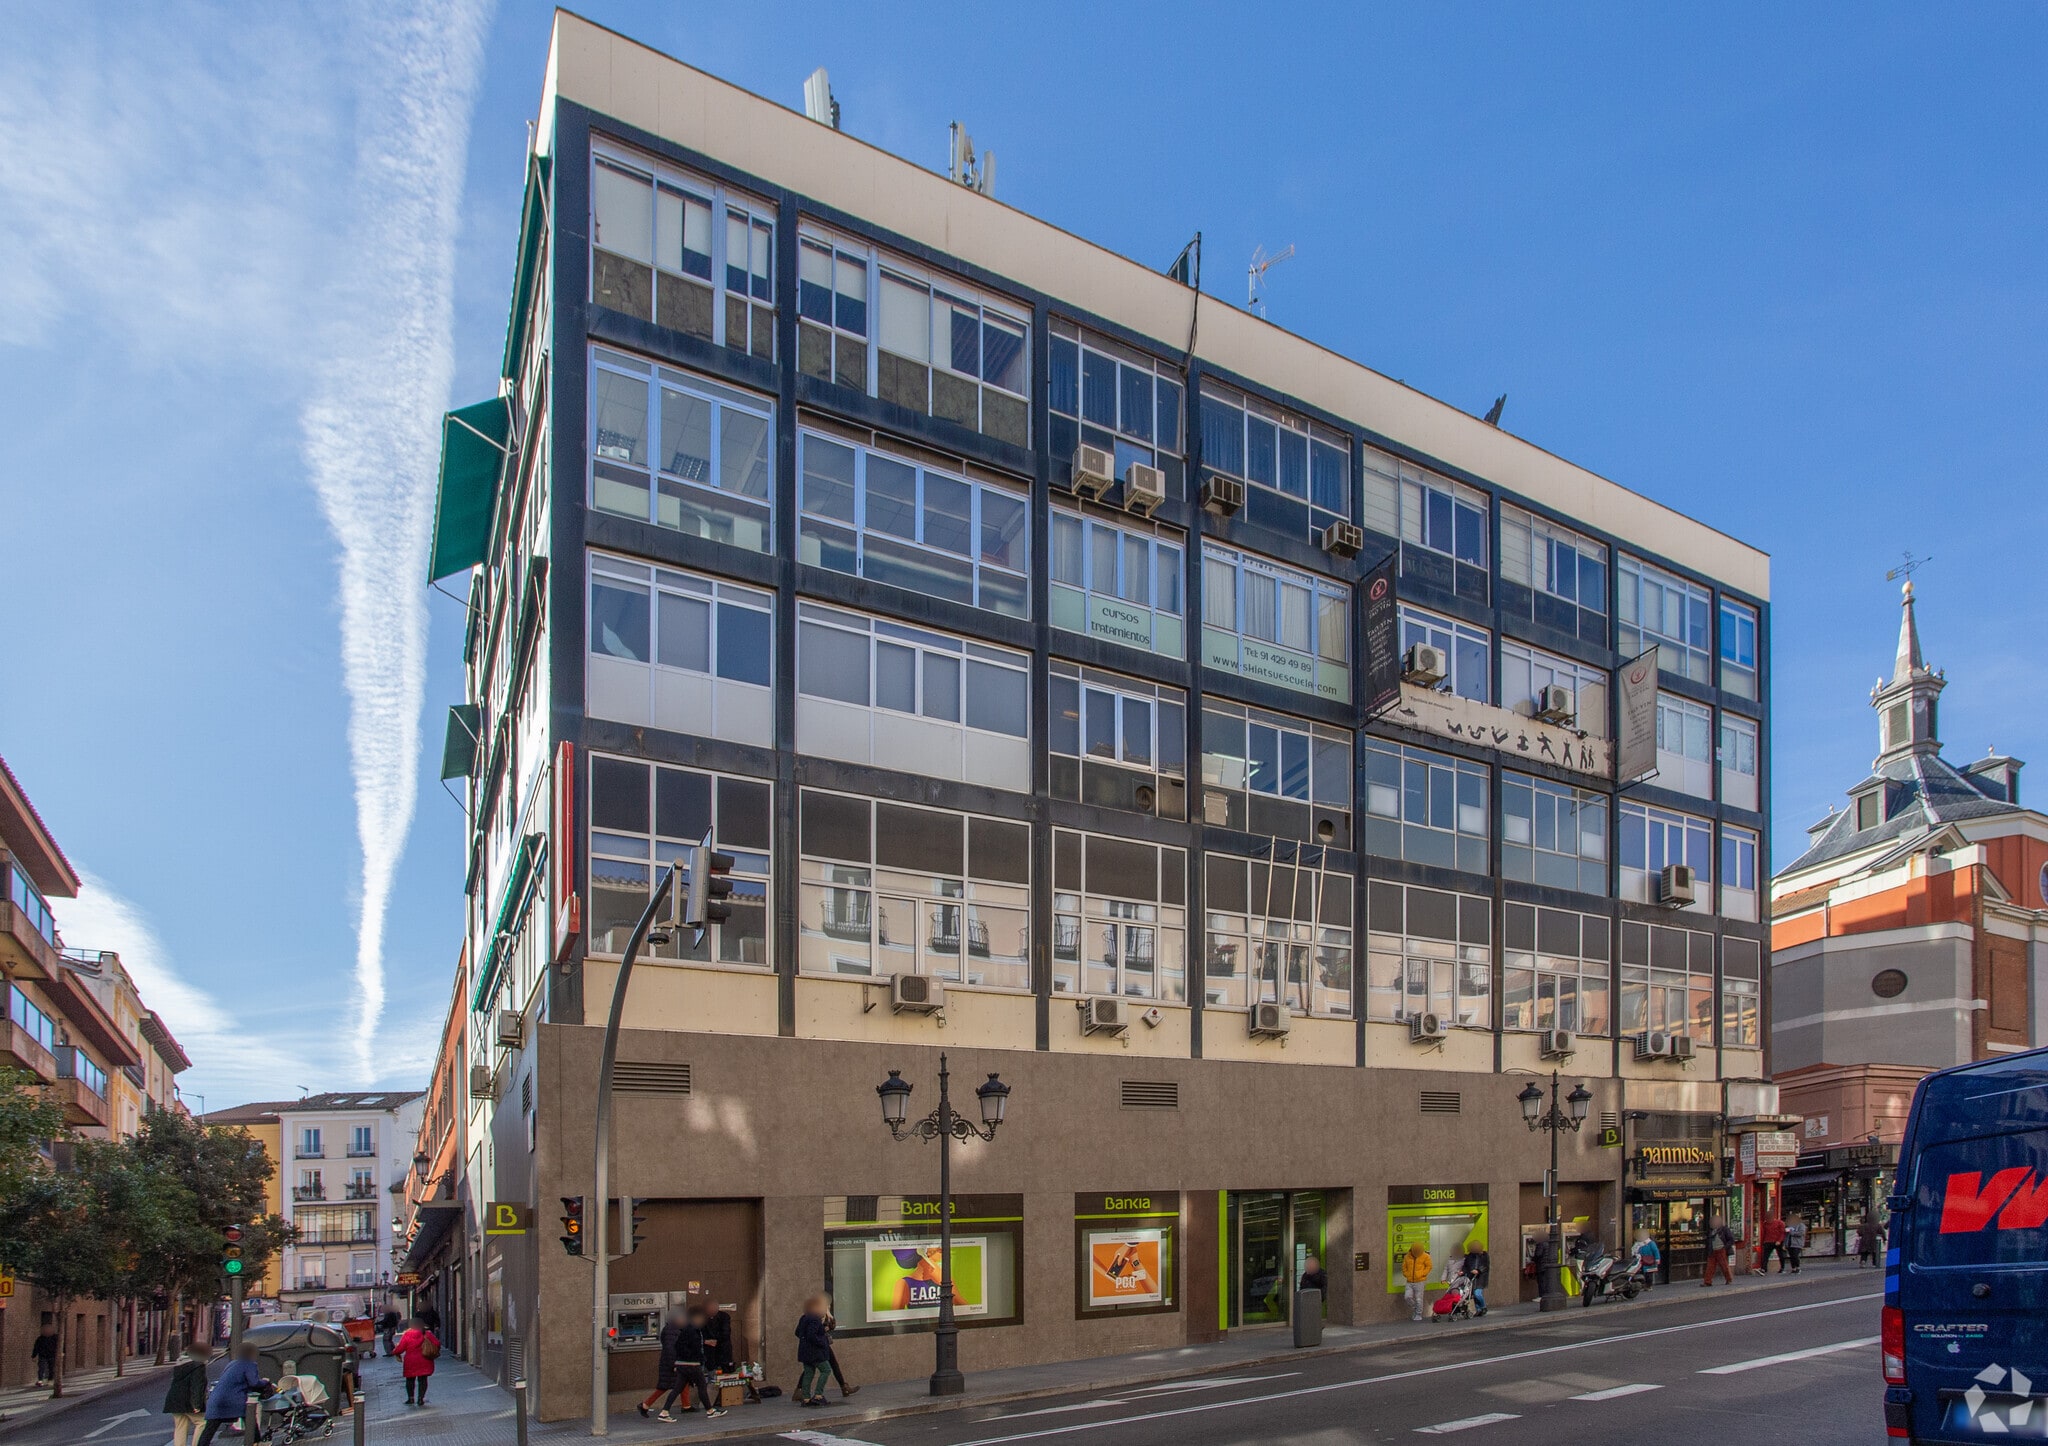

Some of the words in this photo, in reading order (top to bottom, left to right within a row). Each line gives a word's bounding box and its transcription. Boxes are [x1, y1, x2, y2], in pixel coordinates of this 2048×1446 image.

[1260, 651, 1269, 661] 91
[1270, 654, 1287, 666] 429
[1287, 659, 1300, 669] 49
[1300, 663, 1312, 673] 89
[1605, 1129, 1618, 1144] B
[1423, 1188, 1456, 1200] Bankia
[900, 1200, 956, 1215] Banka
[1105, 1196, 1151, 1210] Bankia
[496, 1204, 518, 1226] B
[623, 1298, 654, 1306] Bankia
[1913, 1323, 1989, 1333] CRAFTER
